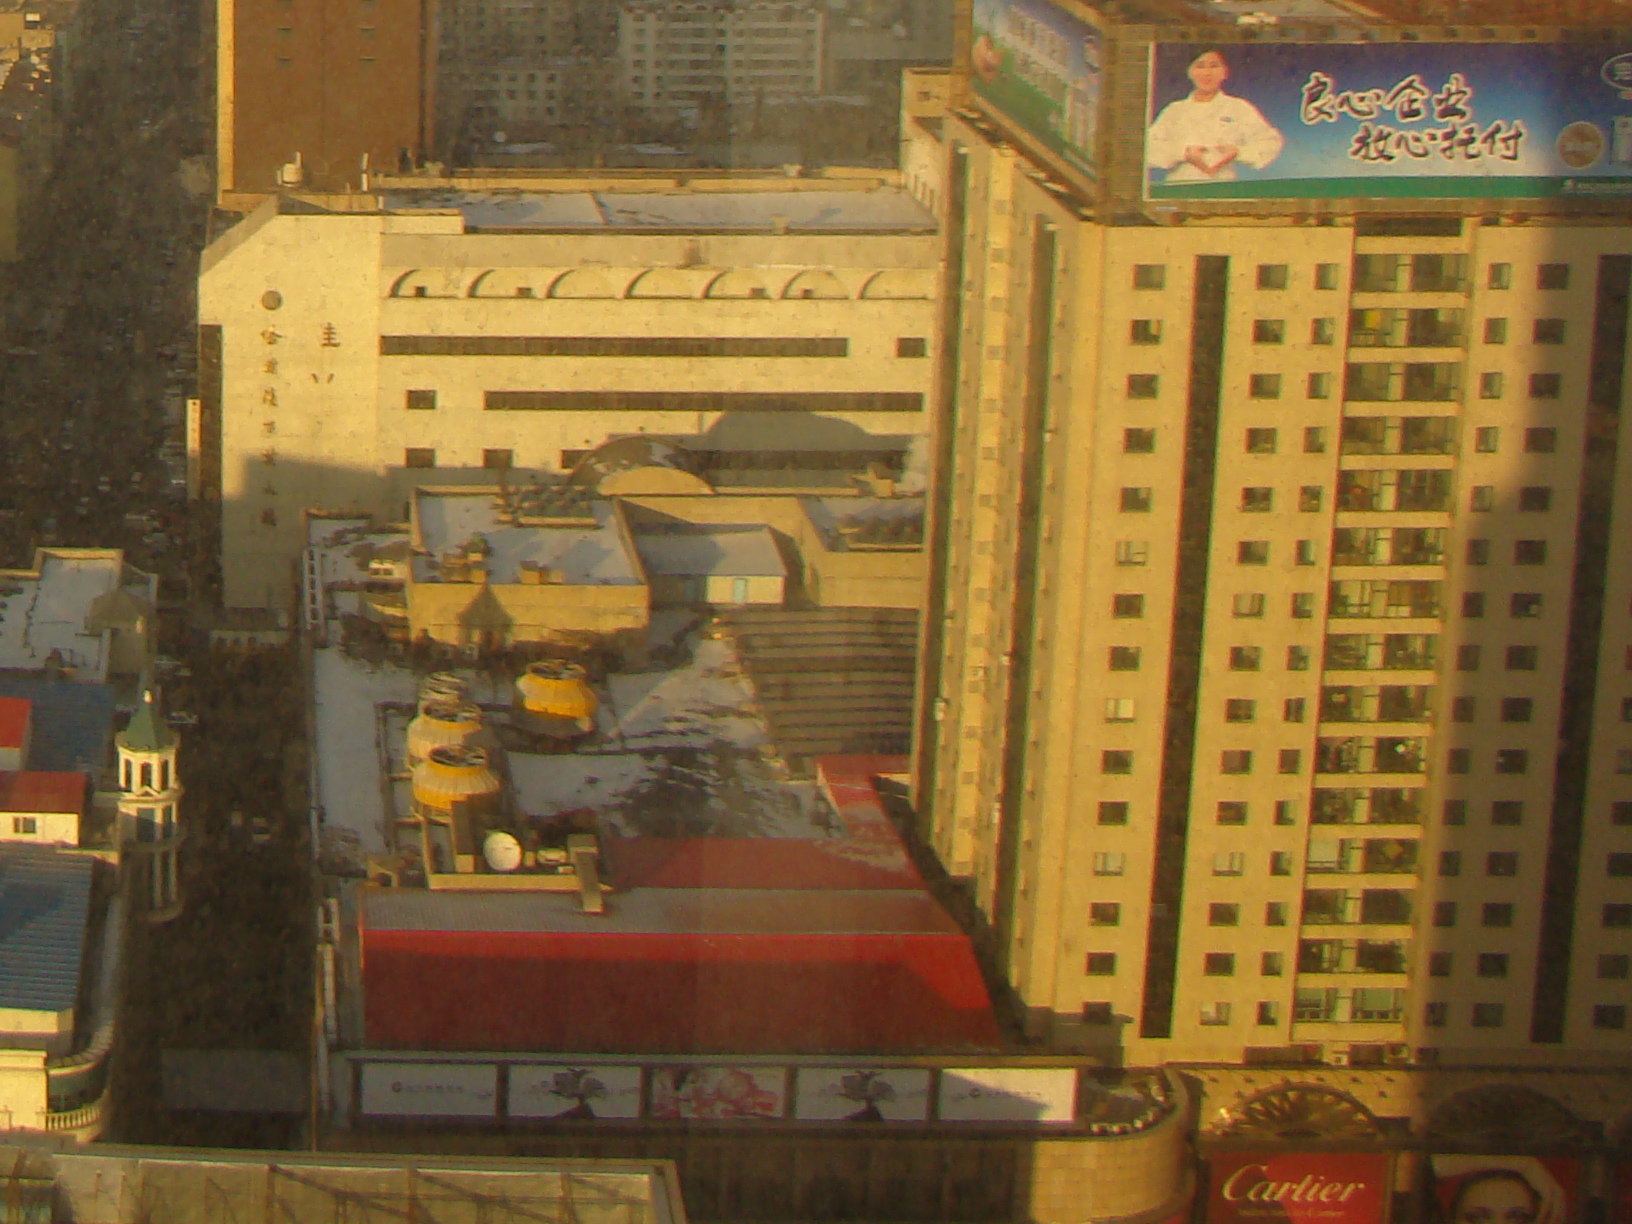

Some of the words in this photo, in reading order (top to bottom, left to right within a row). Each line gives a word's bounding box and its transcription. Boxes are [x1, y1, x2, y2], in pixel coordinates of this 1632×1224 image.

[1301, 72, 1472, 124] 良心企业
[1348, 121, 1528, 162] 放心托付
[1222, 1164, 1366, 1202] Cartier
